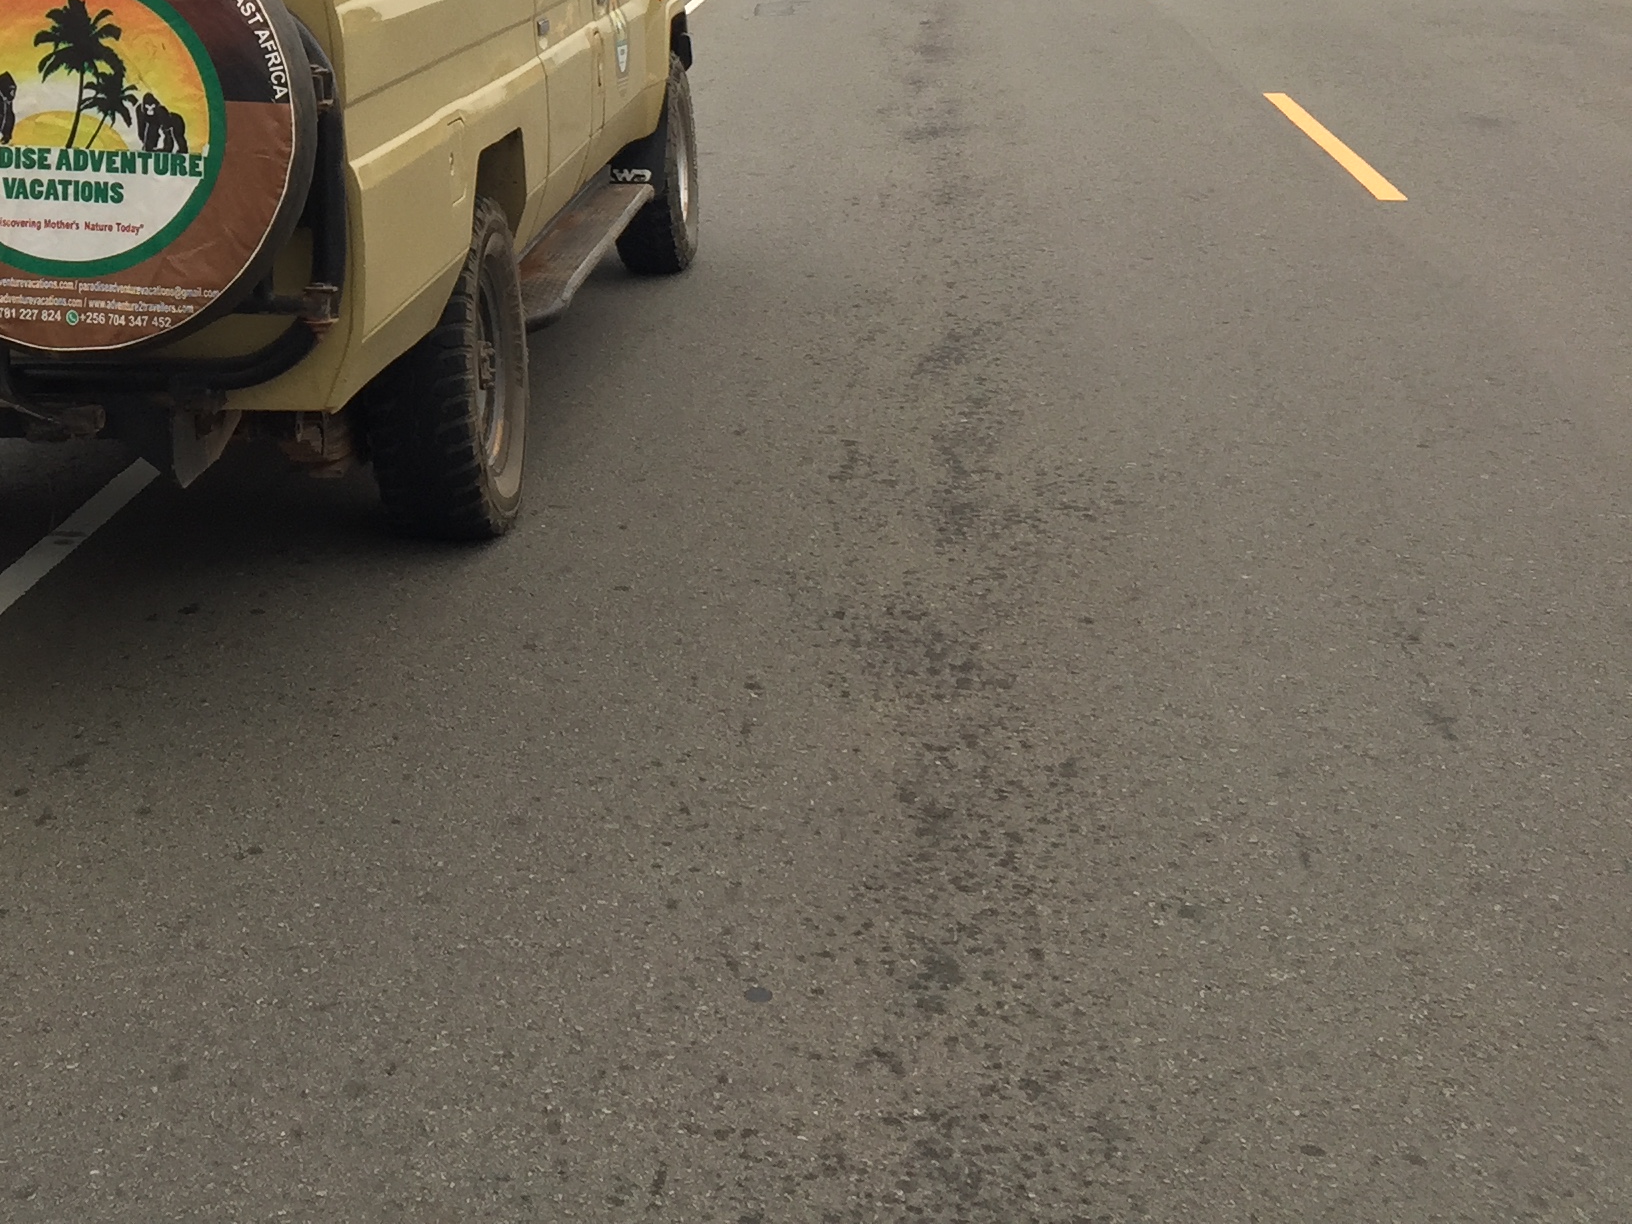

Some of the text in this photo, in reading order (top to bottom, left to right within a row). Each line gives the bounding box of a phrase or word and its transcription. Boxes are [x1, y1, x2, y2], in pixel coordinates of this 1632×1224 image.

[254, 29, 288, 100] AFRICA
[55, 147, 204, 178] ADVENTURE
[2, 177, 124, 204] VACATIONS
[84, 220, 113, 232] Nature
[19, 308, 38, 321] 227
[41, 309, 61, 322] 824
[79, 311, 172, 328] +256 704 347 452
